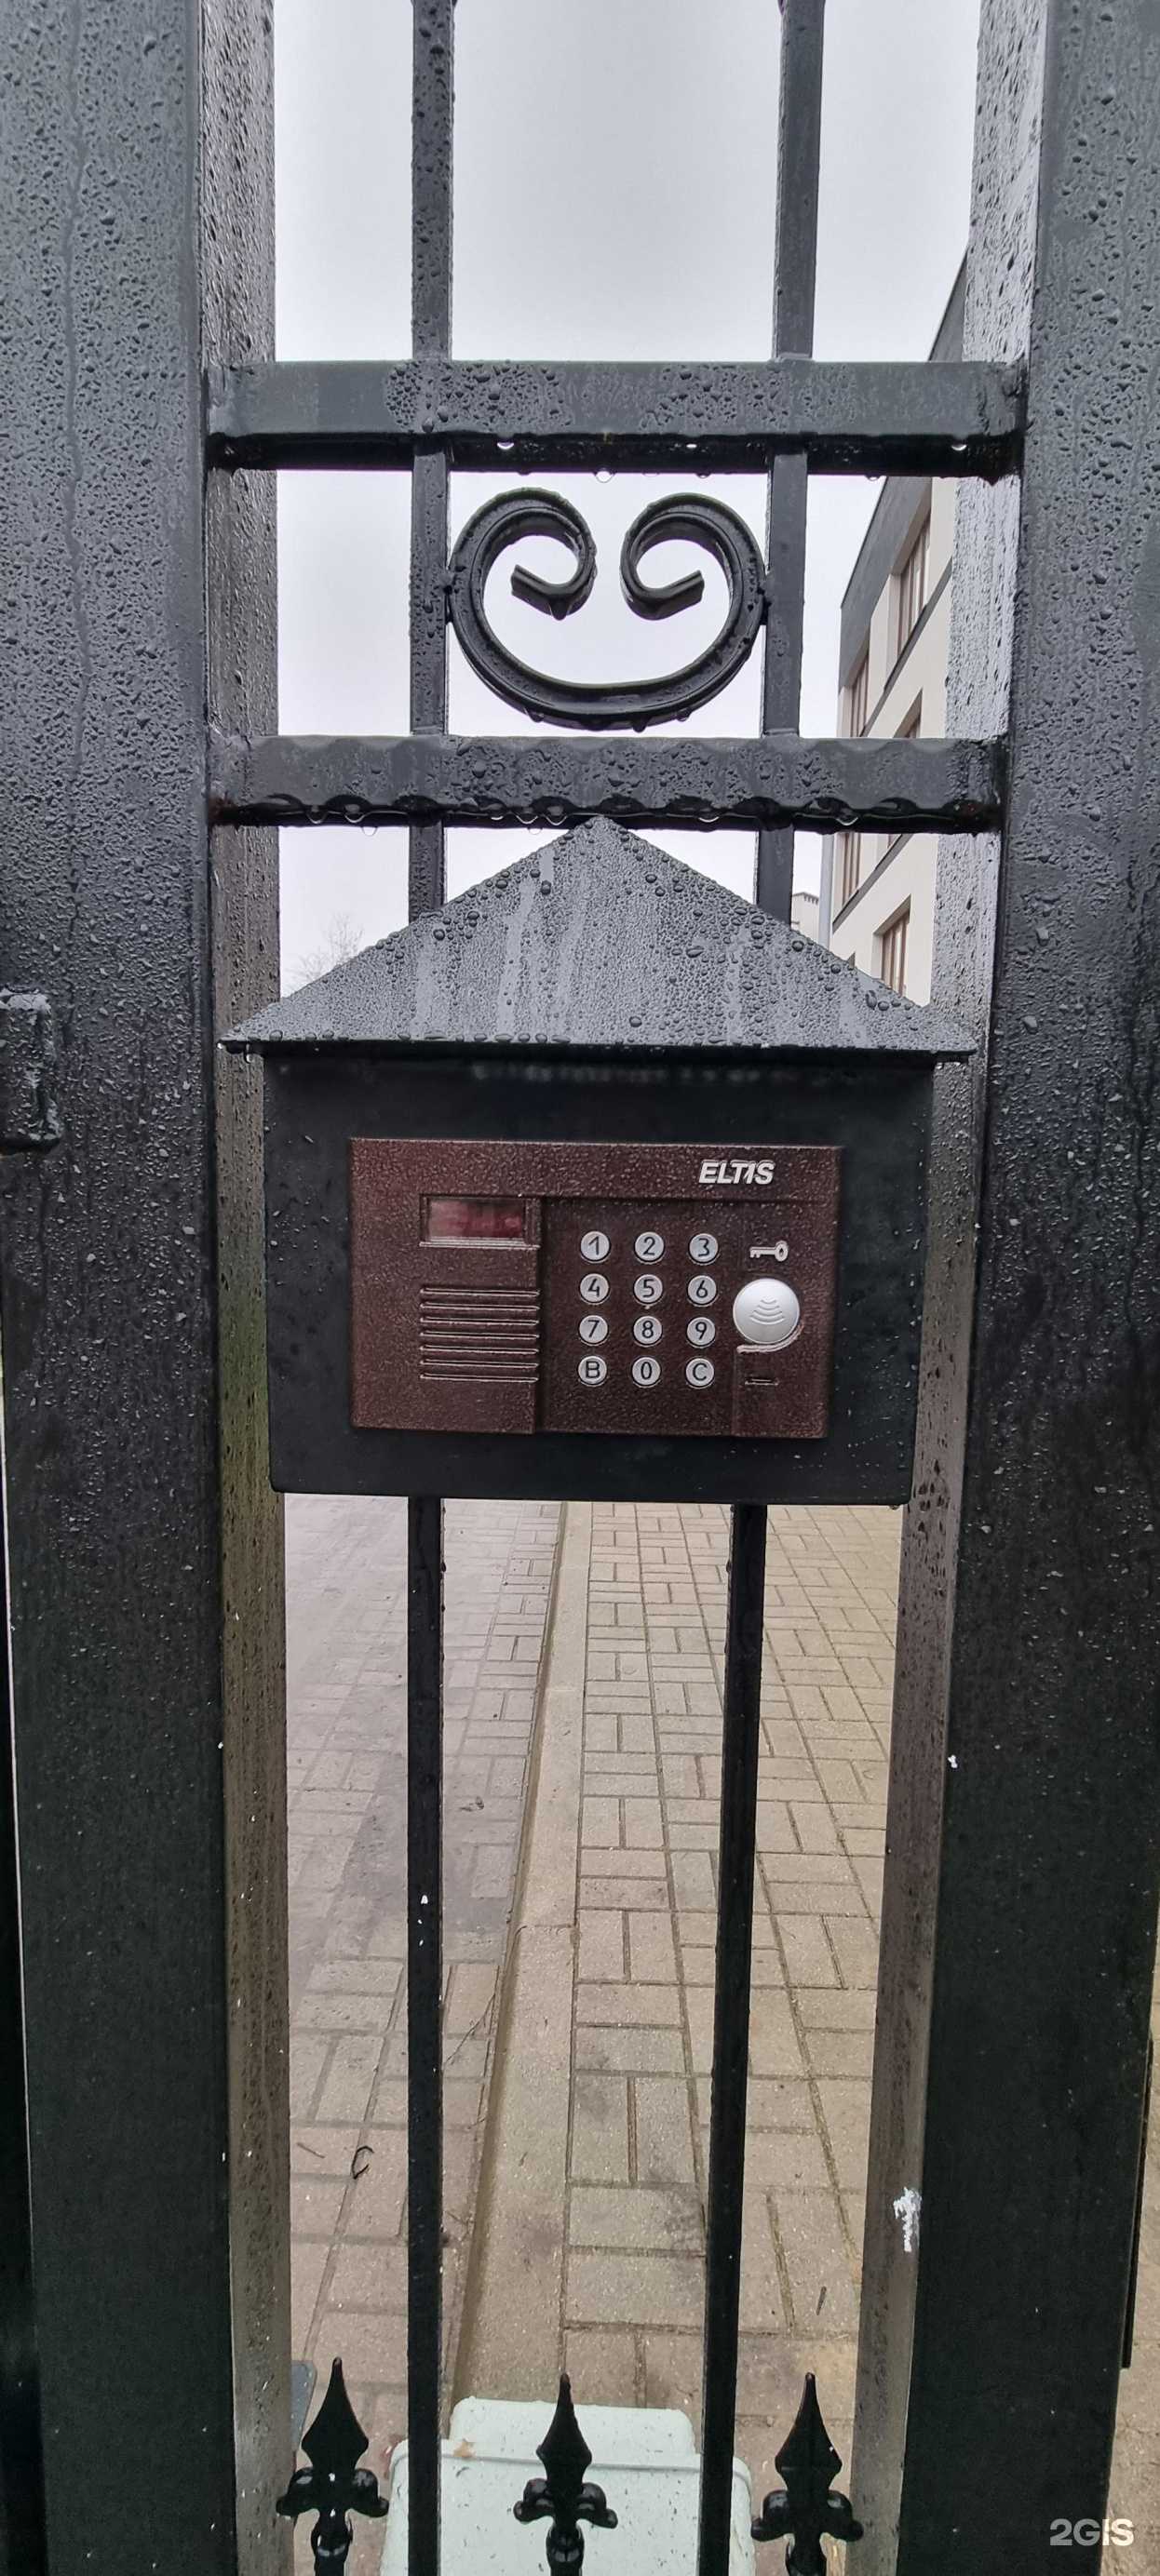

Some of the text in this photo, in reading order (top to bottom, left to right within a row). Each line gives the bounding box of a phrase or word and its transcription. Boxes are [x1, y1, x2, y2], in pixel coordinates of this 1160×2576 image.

[698, 1161, 776, 1185] ELTIS
[588, 1236, 710, 1257] 1 2 3
[587, 1278, 708, 1298] 4 5 6
[587, 1320, 708, 1340] 7 8 9
[585, 1361, 708, 1381] B 0 C
